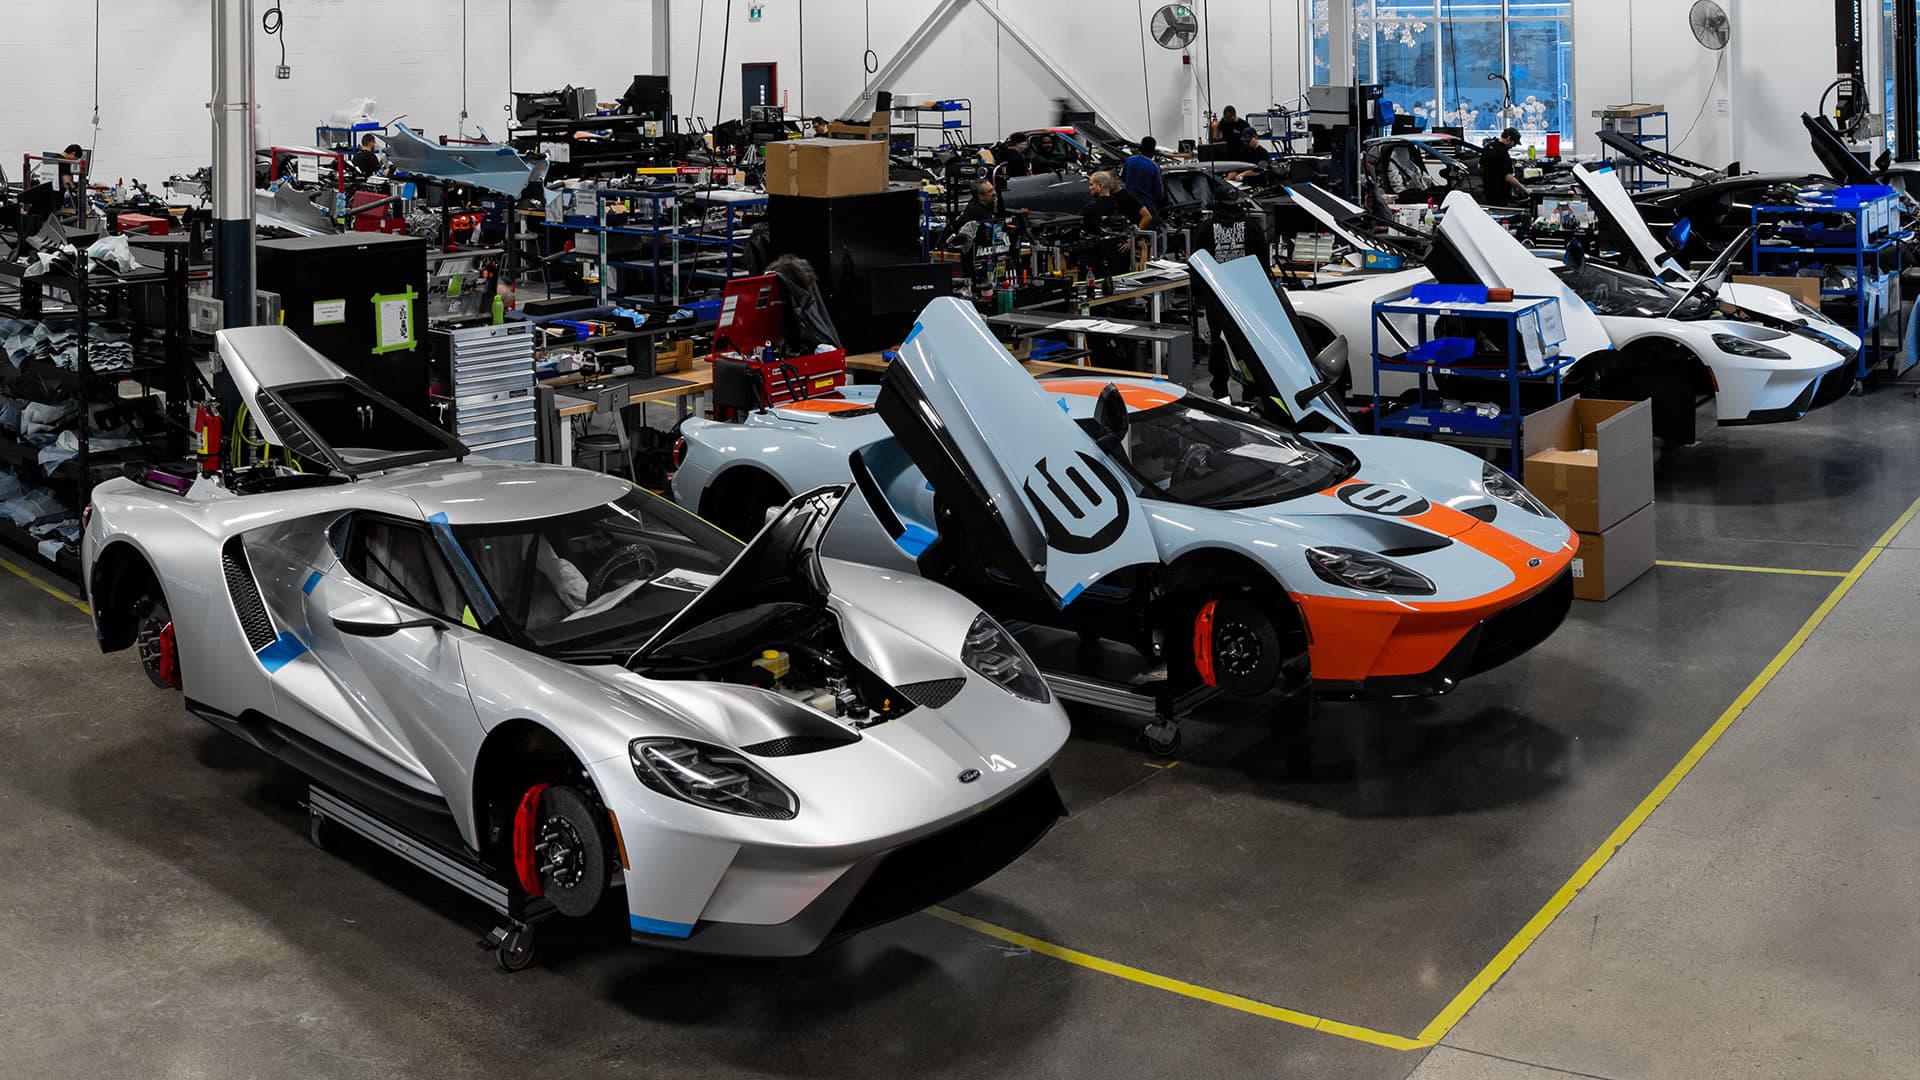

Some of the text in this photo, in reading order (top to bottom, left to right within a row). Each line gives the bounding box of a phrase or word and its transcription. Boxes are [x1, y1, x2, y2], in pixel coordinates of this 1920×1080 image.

[976, 243, 1010, 257] MAXMUM
[1026, 450, 1121, 541] 9
[1348, 483, 1424, 513] 9
